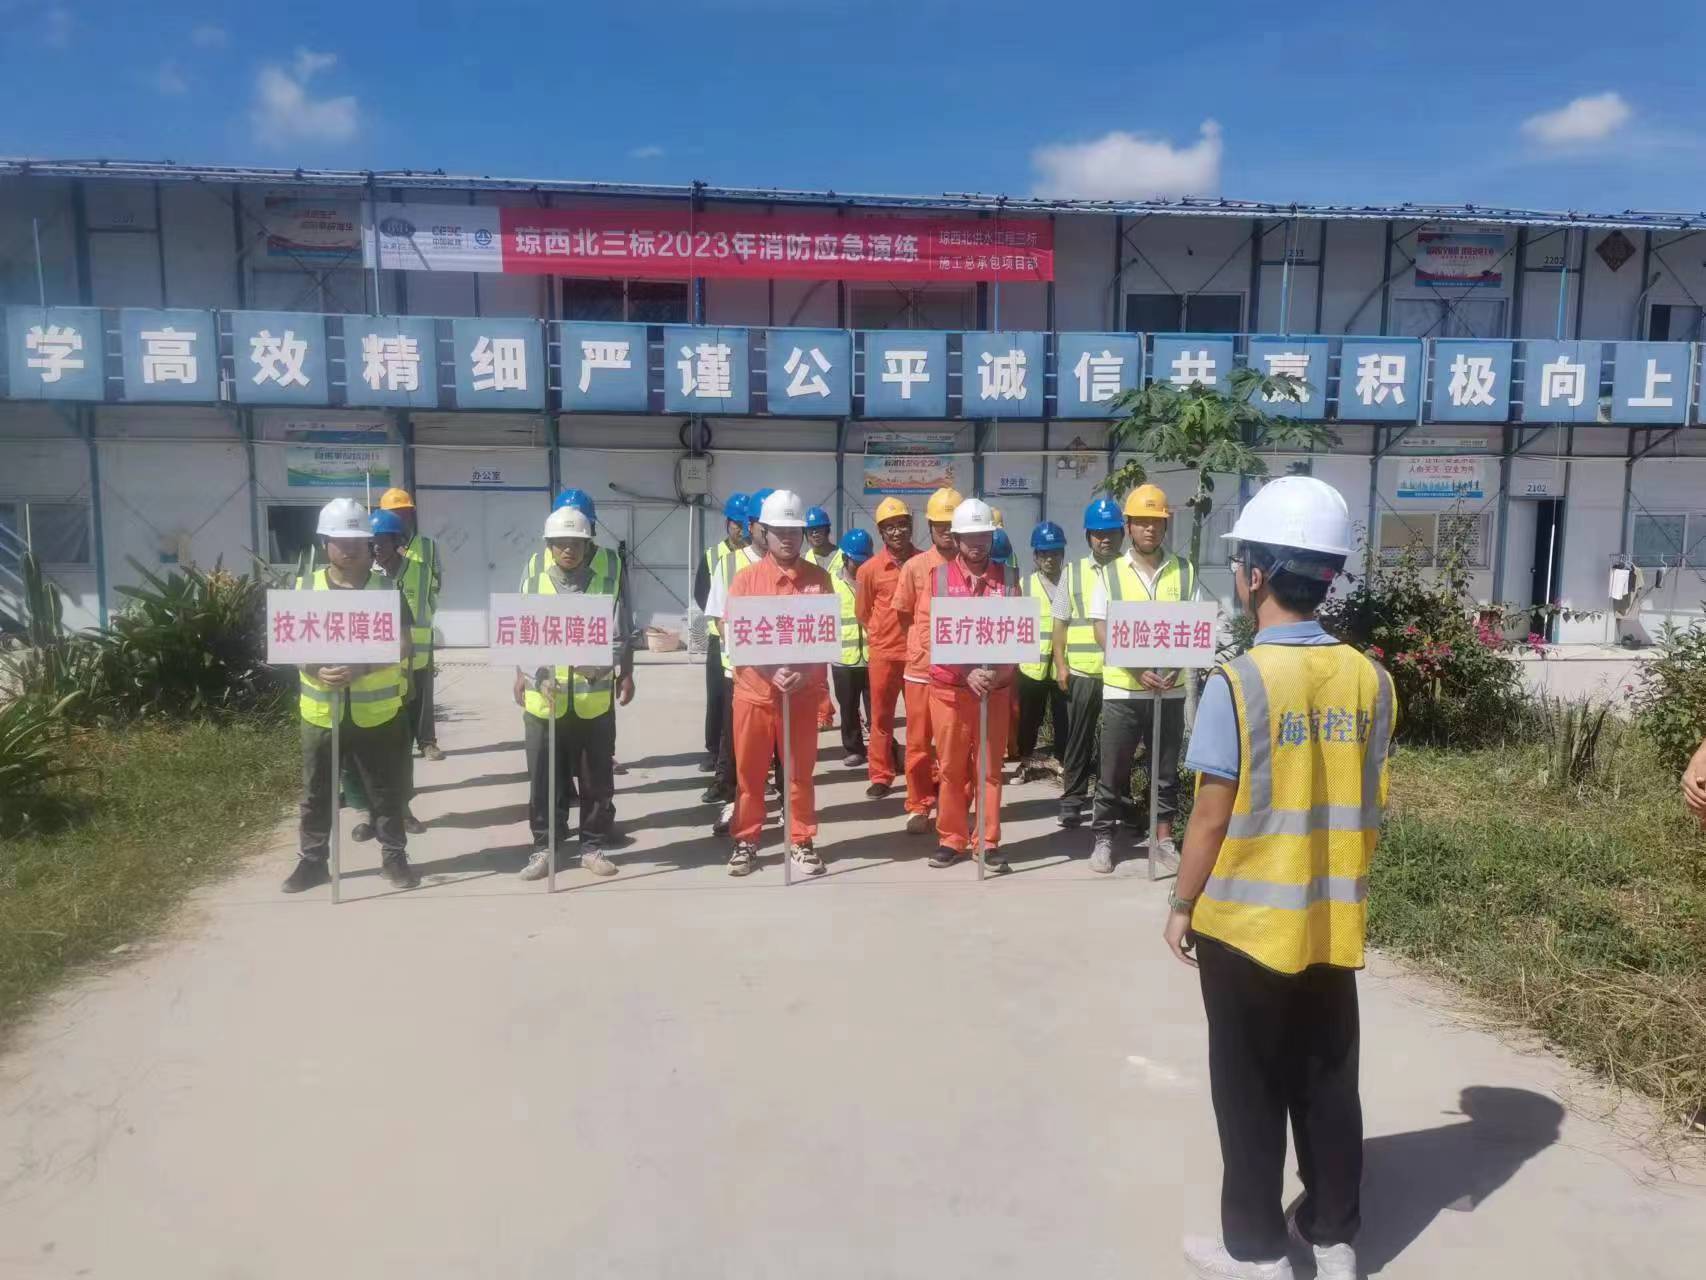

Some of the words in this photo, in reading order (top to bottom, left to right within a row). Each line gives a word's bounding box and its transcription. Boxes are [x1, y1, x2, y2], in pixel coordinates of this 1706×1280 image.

[514, 226, 919, 263] 琼西北三标2023年消防应急演练
[938, 230, 1039, 247] 琼西北供水工程三标
[938, 255, 1039, 271] 施工总承包项目部
[471, 471, 502, 481] 办公室
[273, 610, 397, 644] 技术保障组
[496, 614, 609, 646] 后勤保障组
[733, 614, 837, 646] 安全警戒组
[935, 615, 1036, 646] 医疗救护组
[1112, 620, 1211, 649] 抢险突击组
